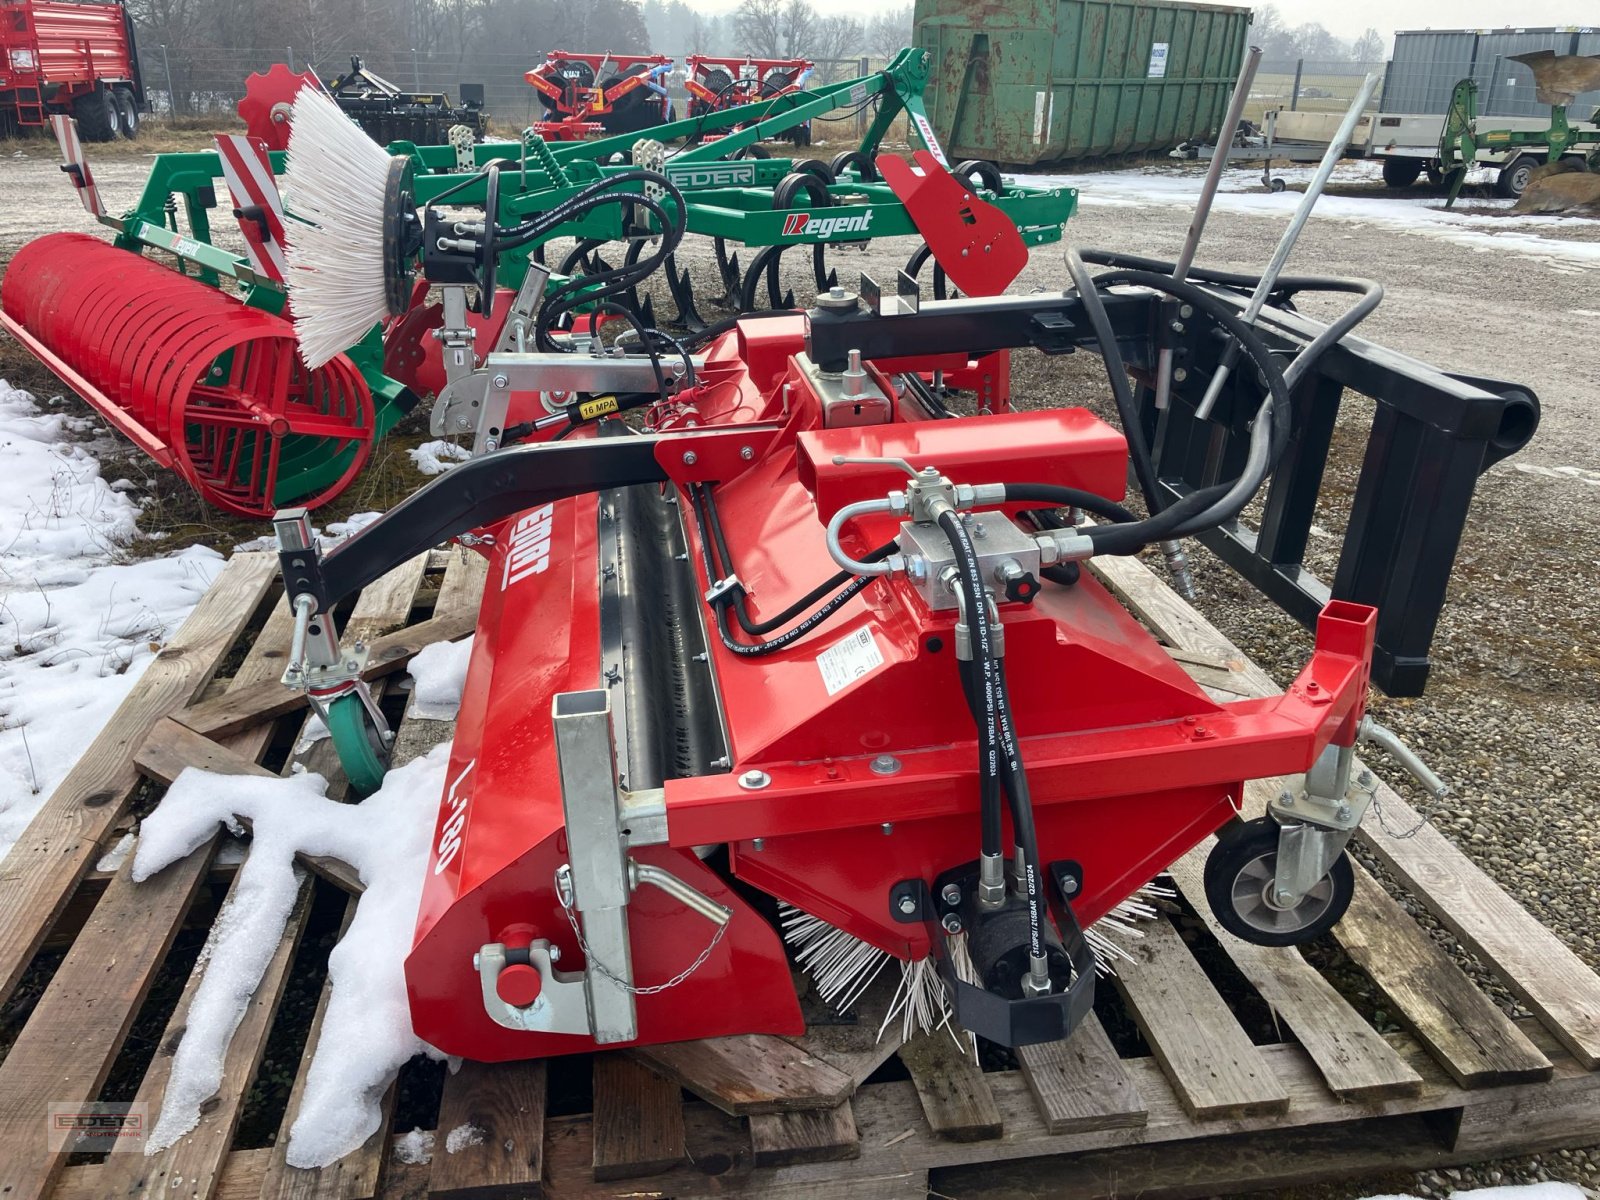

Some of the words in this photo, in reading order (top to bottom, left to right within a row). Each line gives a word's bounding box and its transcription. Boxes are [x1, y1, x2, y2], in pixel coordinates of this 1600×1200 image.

[919, 119, 942, 159] Tukan
[669, 169, 753, 187] EDER
[781, 209, 874, 239] Regent
[583, 406, 594, 416] 16
[595, 400, 616, 412] MPA
[961, 538, 972, 554] R2AT
[967, 558, 976, 568] EN
[969, 568, 978, 582] 853
[833, 590, 850, 605] R1AT
[972, 582, 981, 598] 2SN
[976, 602, 984, 614] DN
[978, 616, 986, 625] 13
[983, 661, 991, 680] W.P.
[985, 681, 994, 712] 4000PSI
[997, 699, 1004, 710] EN
[987, 717, 995, 746] 275BAR
[1000, 714, 1009, 732] R1AT
[1006, 743, 1015, 757] SAE
[989, 750, 997, 777] Q2/2024
[1010, 760, 1017, 771] HB
[434, 757, 476, 876] L-180
[1027, 864, 1036, 895] Q2/2024
[1029, 900, 1038, 927] 215BAR
